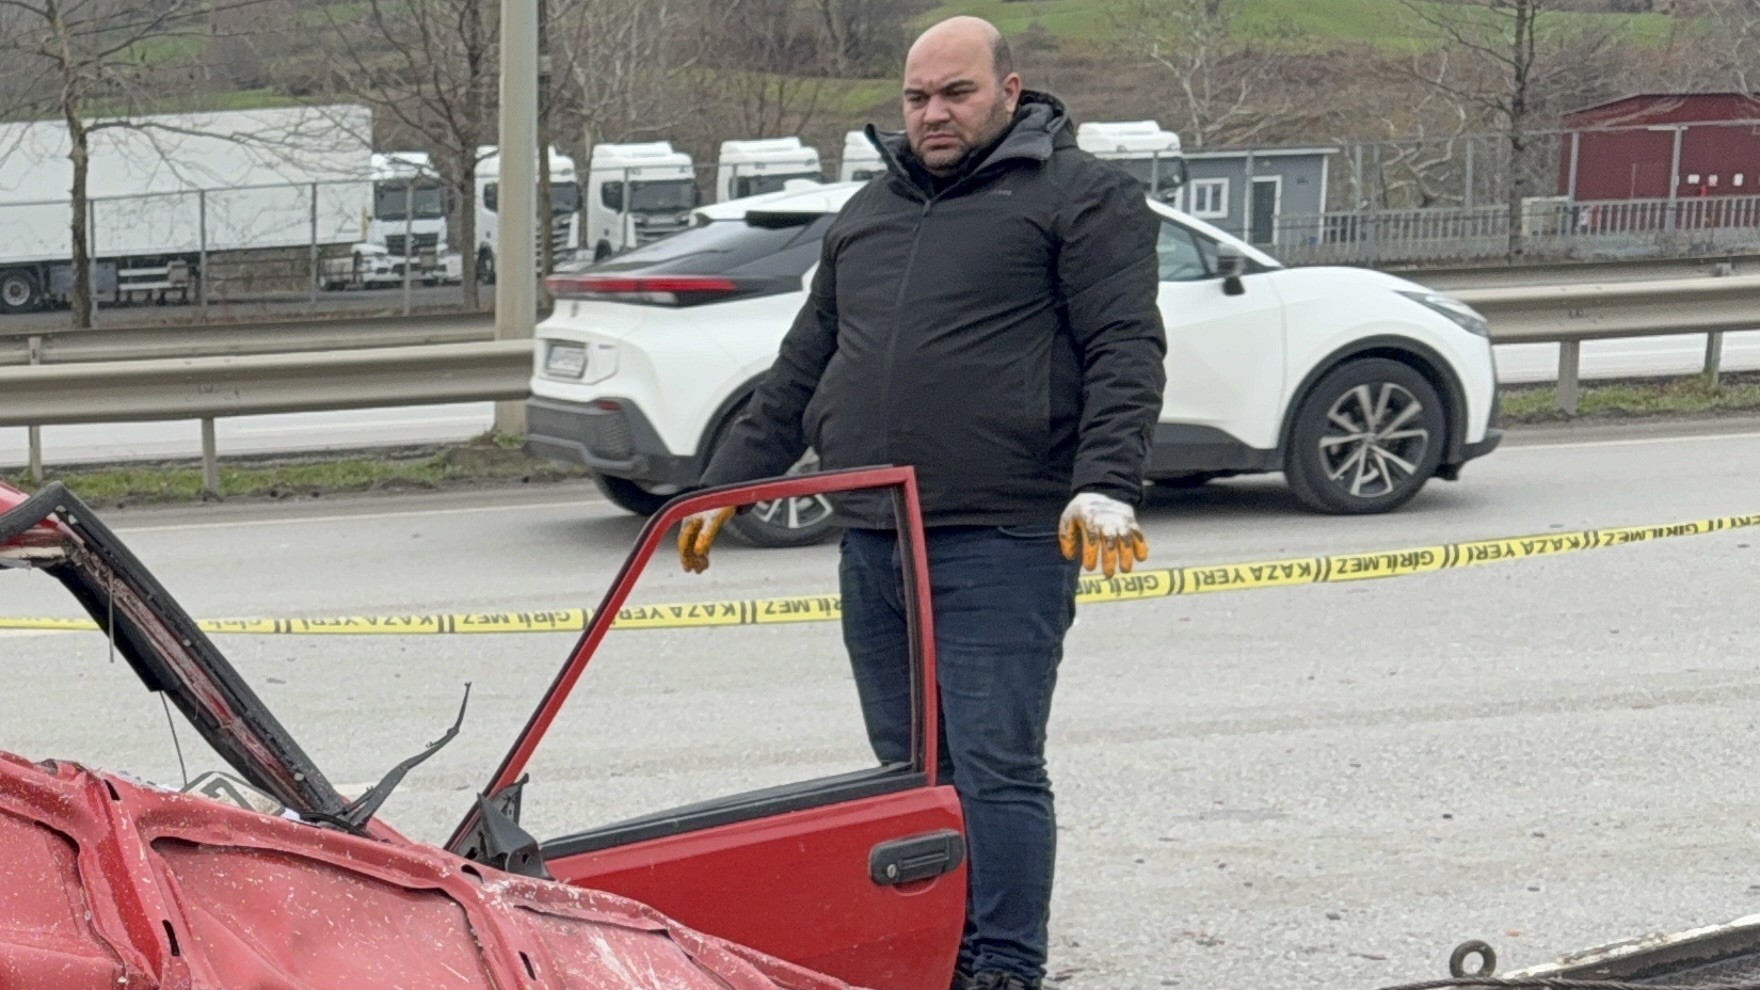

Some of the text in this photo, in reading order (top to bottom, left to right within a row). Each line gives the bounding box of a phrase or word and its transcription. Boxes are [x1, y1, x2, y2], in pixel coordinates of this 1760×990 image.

[1519, 536, 1581, 556] KAZA
[1248, 562, 1311, 583] KAZA
[1334, 550, 1434, 575] GİRİLMEZ
[1193, 568, 1245, 590] YERİ
